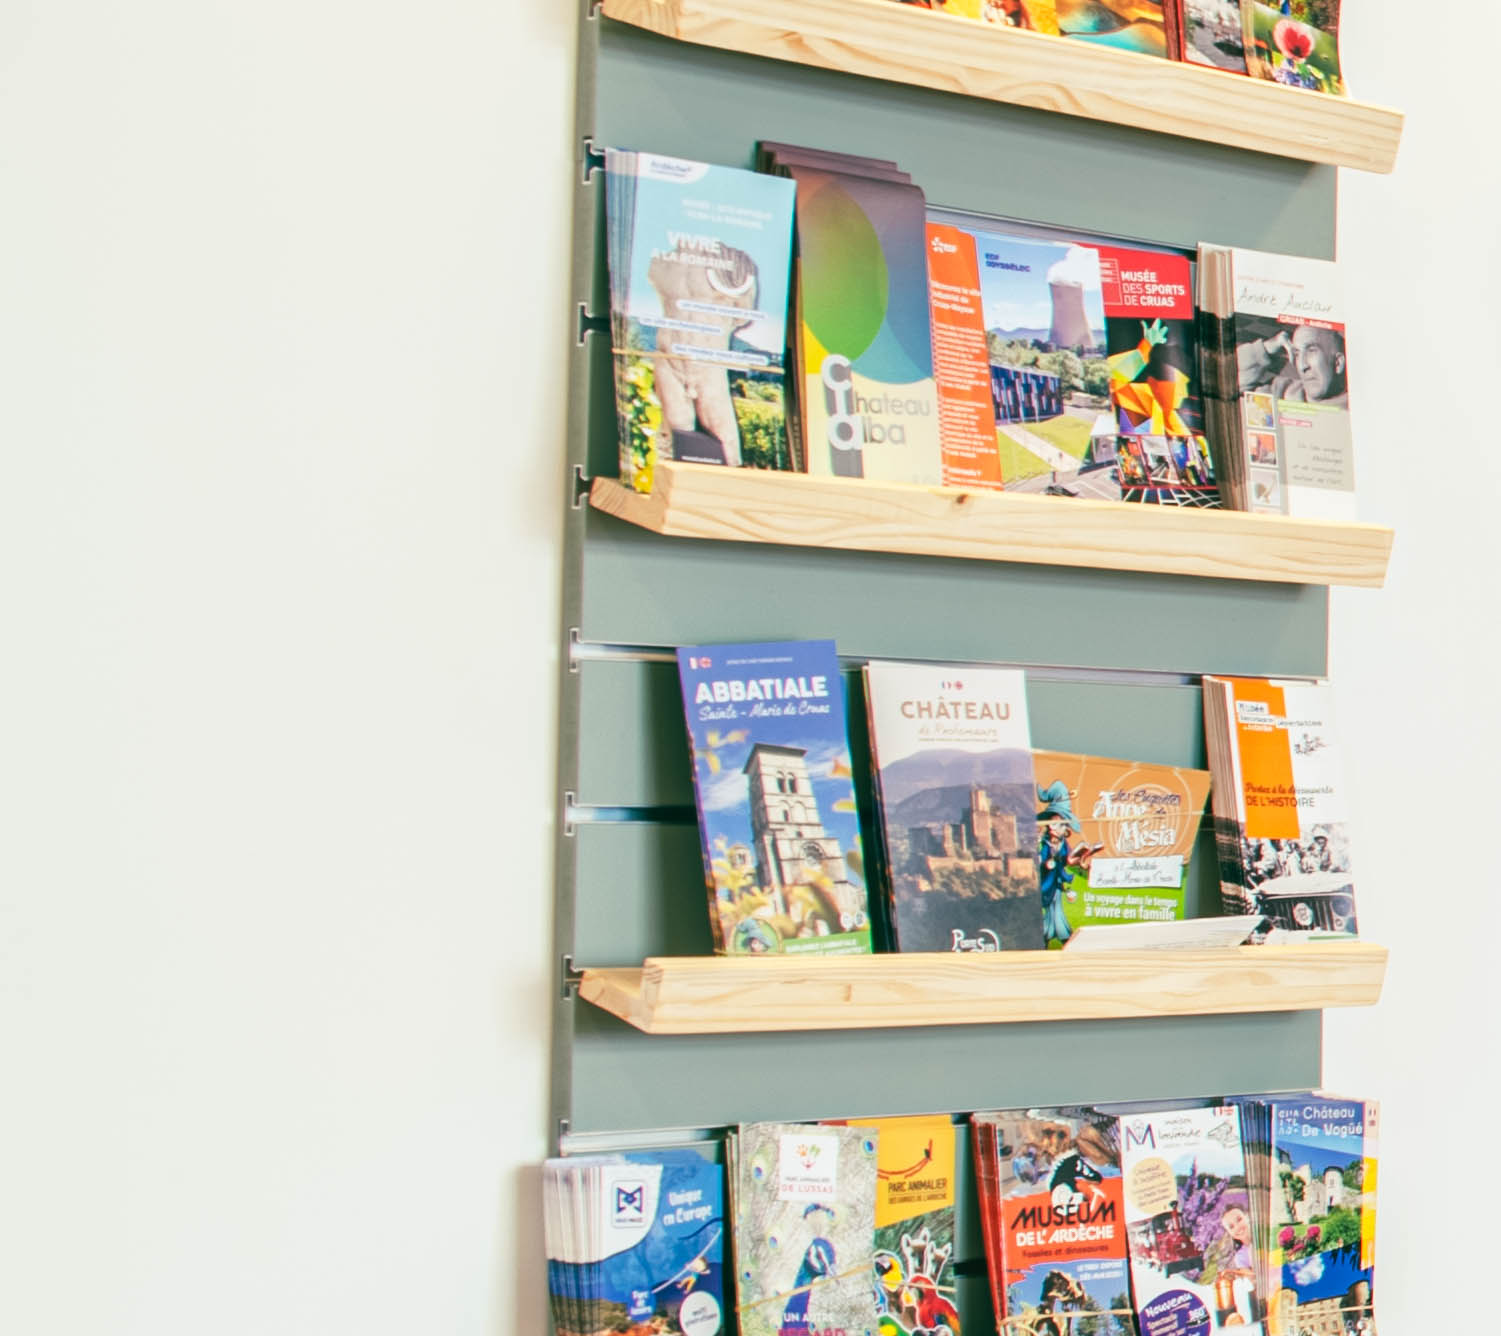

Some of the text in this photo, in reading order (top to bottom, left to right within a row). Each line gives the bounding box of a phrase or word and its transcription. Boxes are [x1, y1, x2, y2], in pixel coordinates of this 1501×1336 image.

[667, 230, 722, 254] VIVRE
[1120, 269, 1158, 283] MUSÉE
[1122, 282, 1186, 297] DES SPORTS
[1123, 294, 1176, 308] DE CRUAS
[695, 675, 830, 705] ABBATIALE
[900, 696, 1011, 721] CHÂTEAU
[1091, 790, 1149, 819] Anne
[1245, 794, 1316, 808] DE L'HISTOIRE
[1084, 903, 1176, 921] à vivre en famille
[1303, 1106, 1356, 1120] Château
[1302, 1124, 1319, 1137] De
[797, 1184, 833, 1194] LUSSAS
[888, 1177, 948, 1195] PARC ANIMALIER
[668, 1189, 703, 1207] Unique
[676, 1204, 713, 1225] Europe
[1010, 1195, 1117, 1231] MUSÉUM
[1015, 1231, 1036, 1247] DE
[783, 1312, 800, 1322] UN
